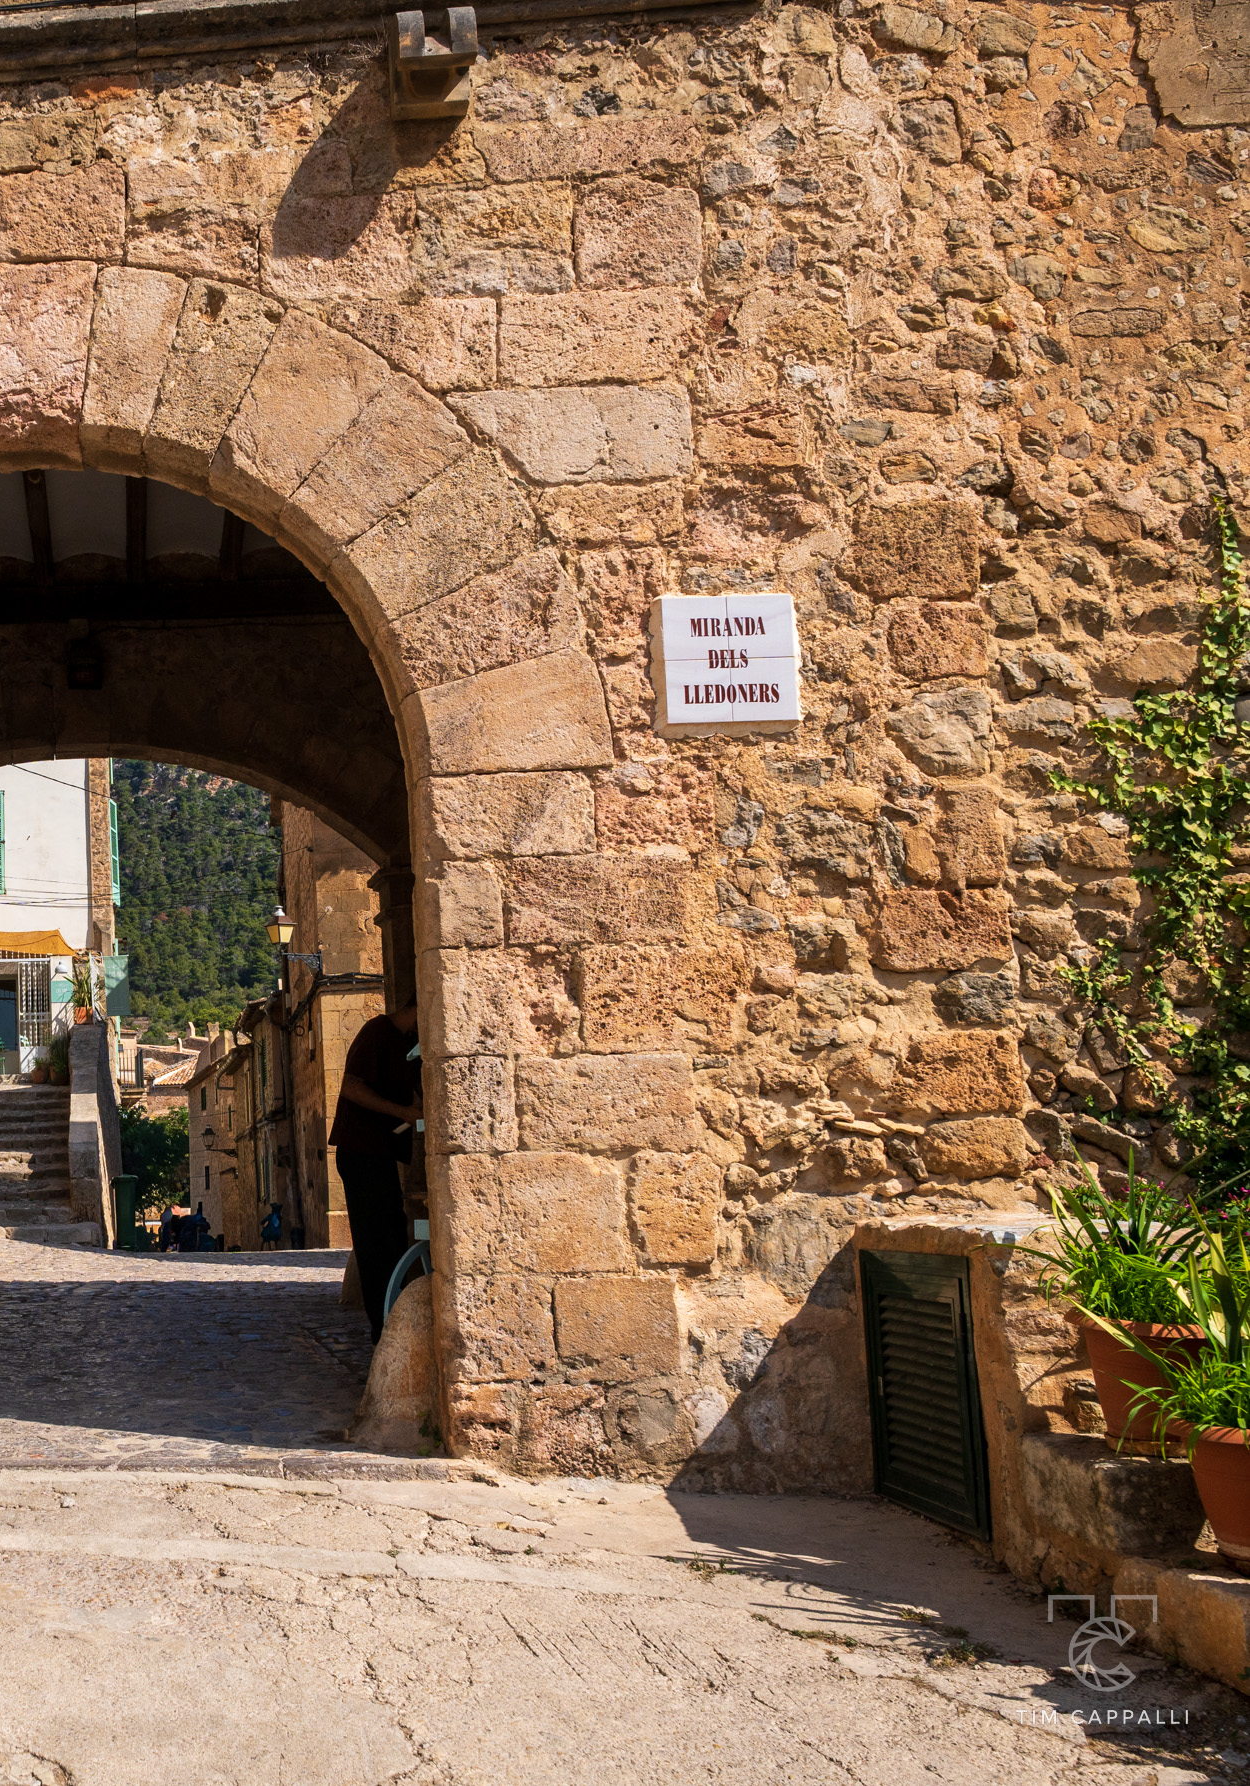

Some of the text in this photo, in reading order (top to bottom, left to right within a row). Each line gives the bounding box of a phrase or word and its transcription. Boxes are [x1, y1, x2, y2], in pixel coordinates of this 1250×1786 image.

[690, 616, 766, 637] MIRANDA
[708, 649, 748, 669] DELS
[684, 683, 780, 704] LLEDONERS
